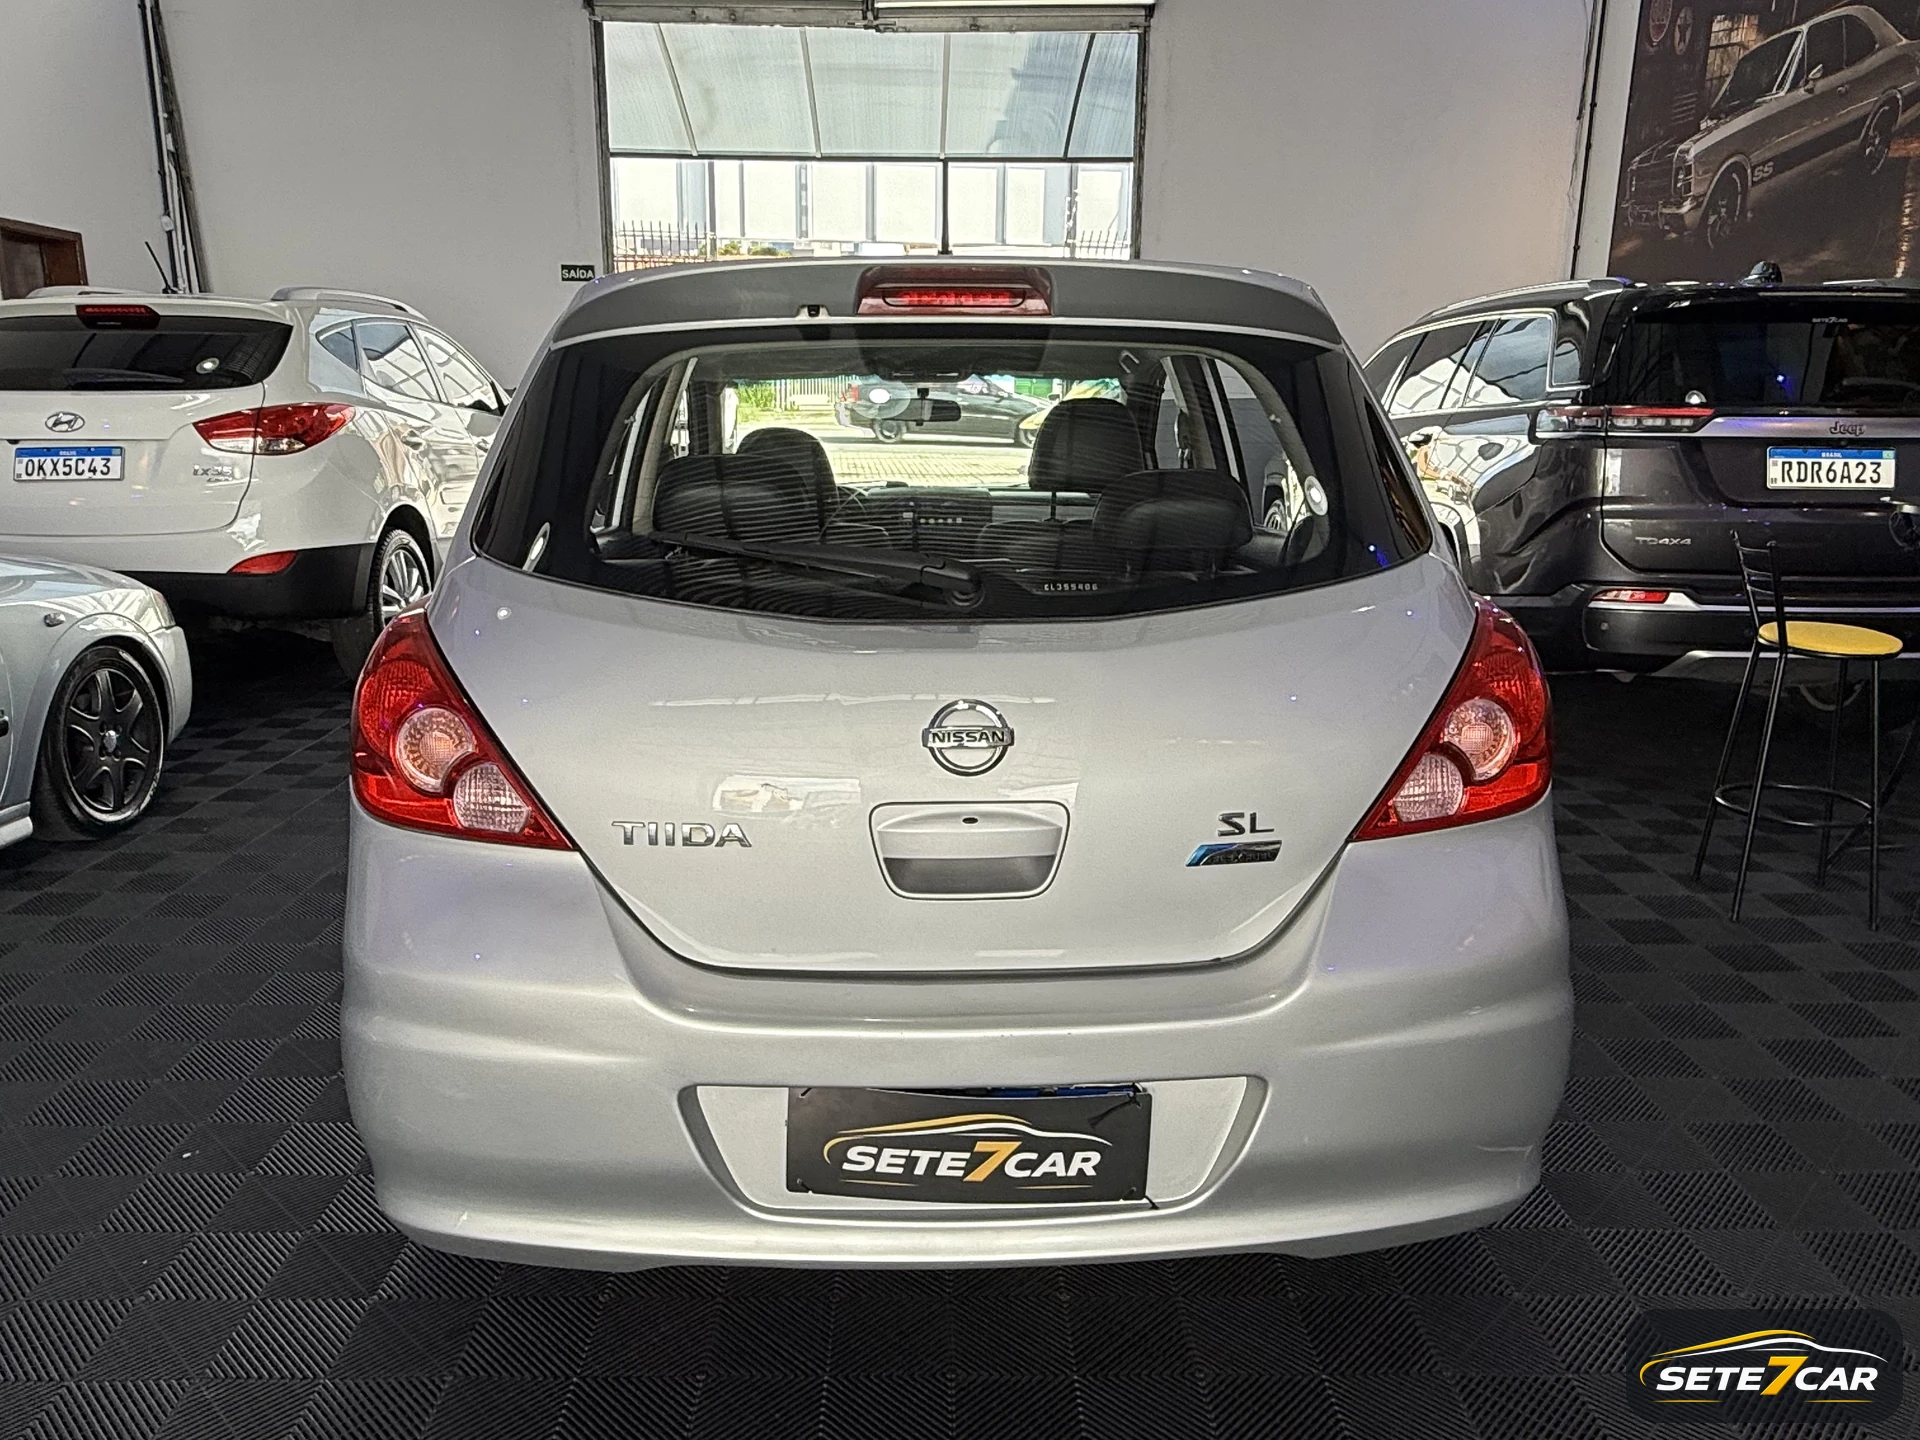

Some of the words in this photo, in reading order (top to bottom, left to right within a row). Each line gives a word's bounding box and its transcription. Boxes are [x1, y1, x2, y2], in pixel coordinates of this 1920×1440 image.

[562, 267, 595, 279] SAÍDA
[1829, 421, 1866, 436] Jeep
[25, 458, 111, 476] OKX5C43
[1781, 461, 1882, 484] RDR6A23
[932, 731, 1005, 743] NISSAN
[1217, 812, 1275, 837] SL
[611, 820, 752, 848] TIIDA
